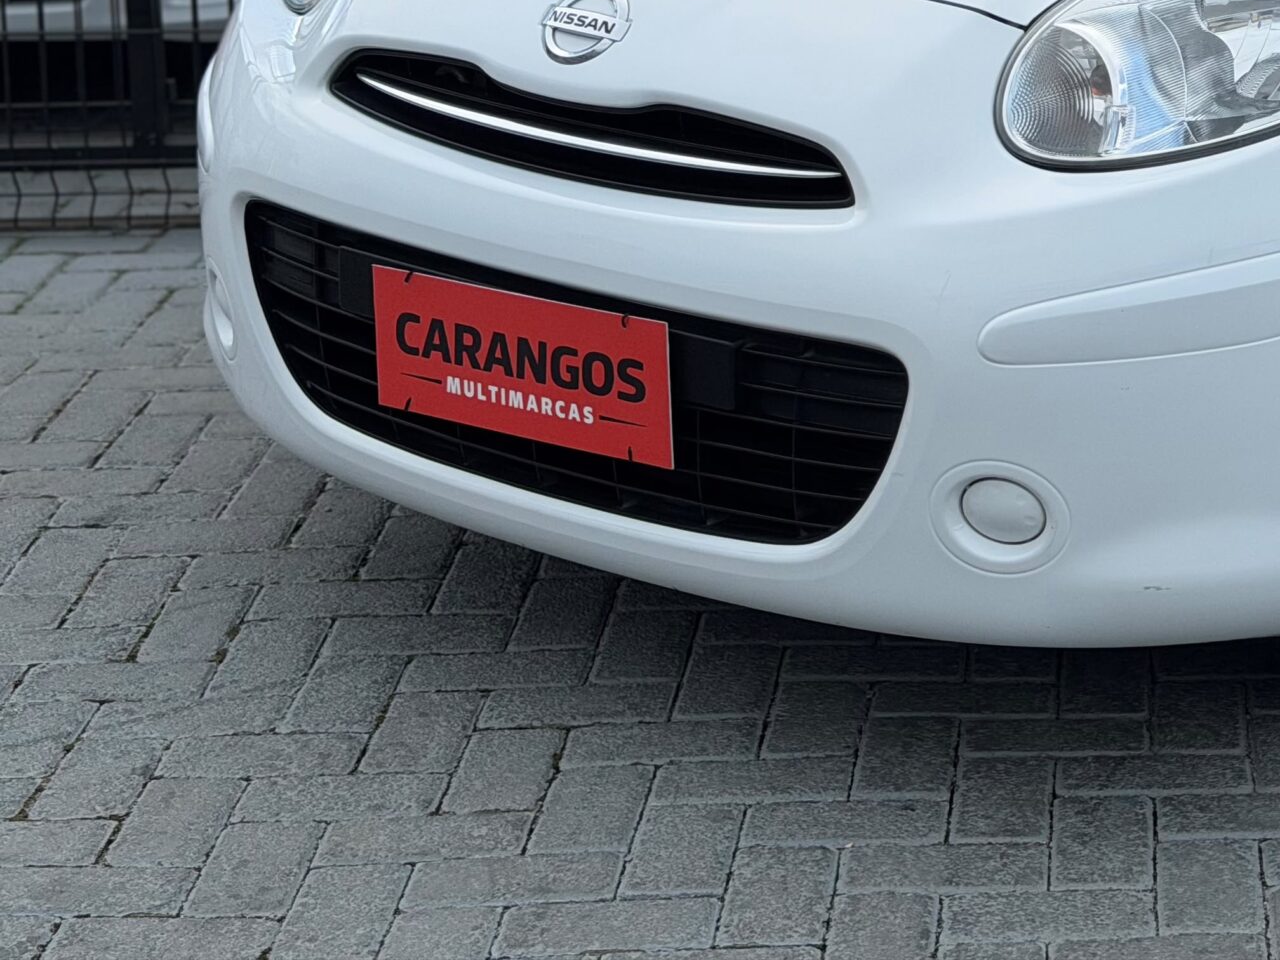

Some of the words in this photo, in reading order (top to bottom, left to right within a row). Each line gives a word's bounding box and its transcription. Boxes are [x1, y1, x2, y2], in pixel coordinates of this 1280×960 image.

[549, 10, 616, 34] NISSAN
[396, 312, 647, 403] CARANGOS
[446, 376, 594, 424] MULTIMARCAS
